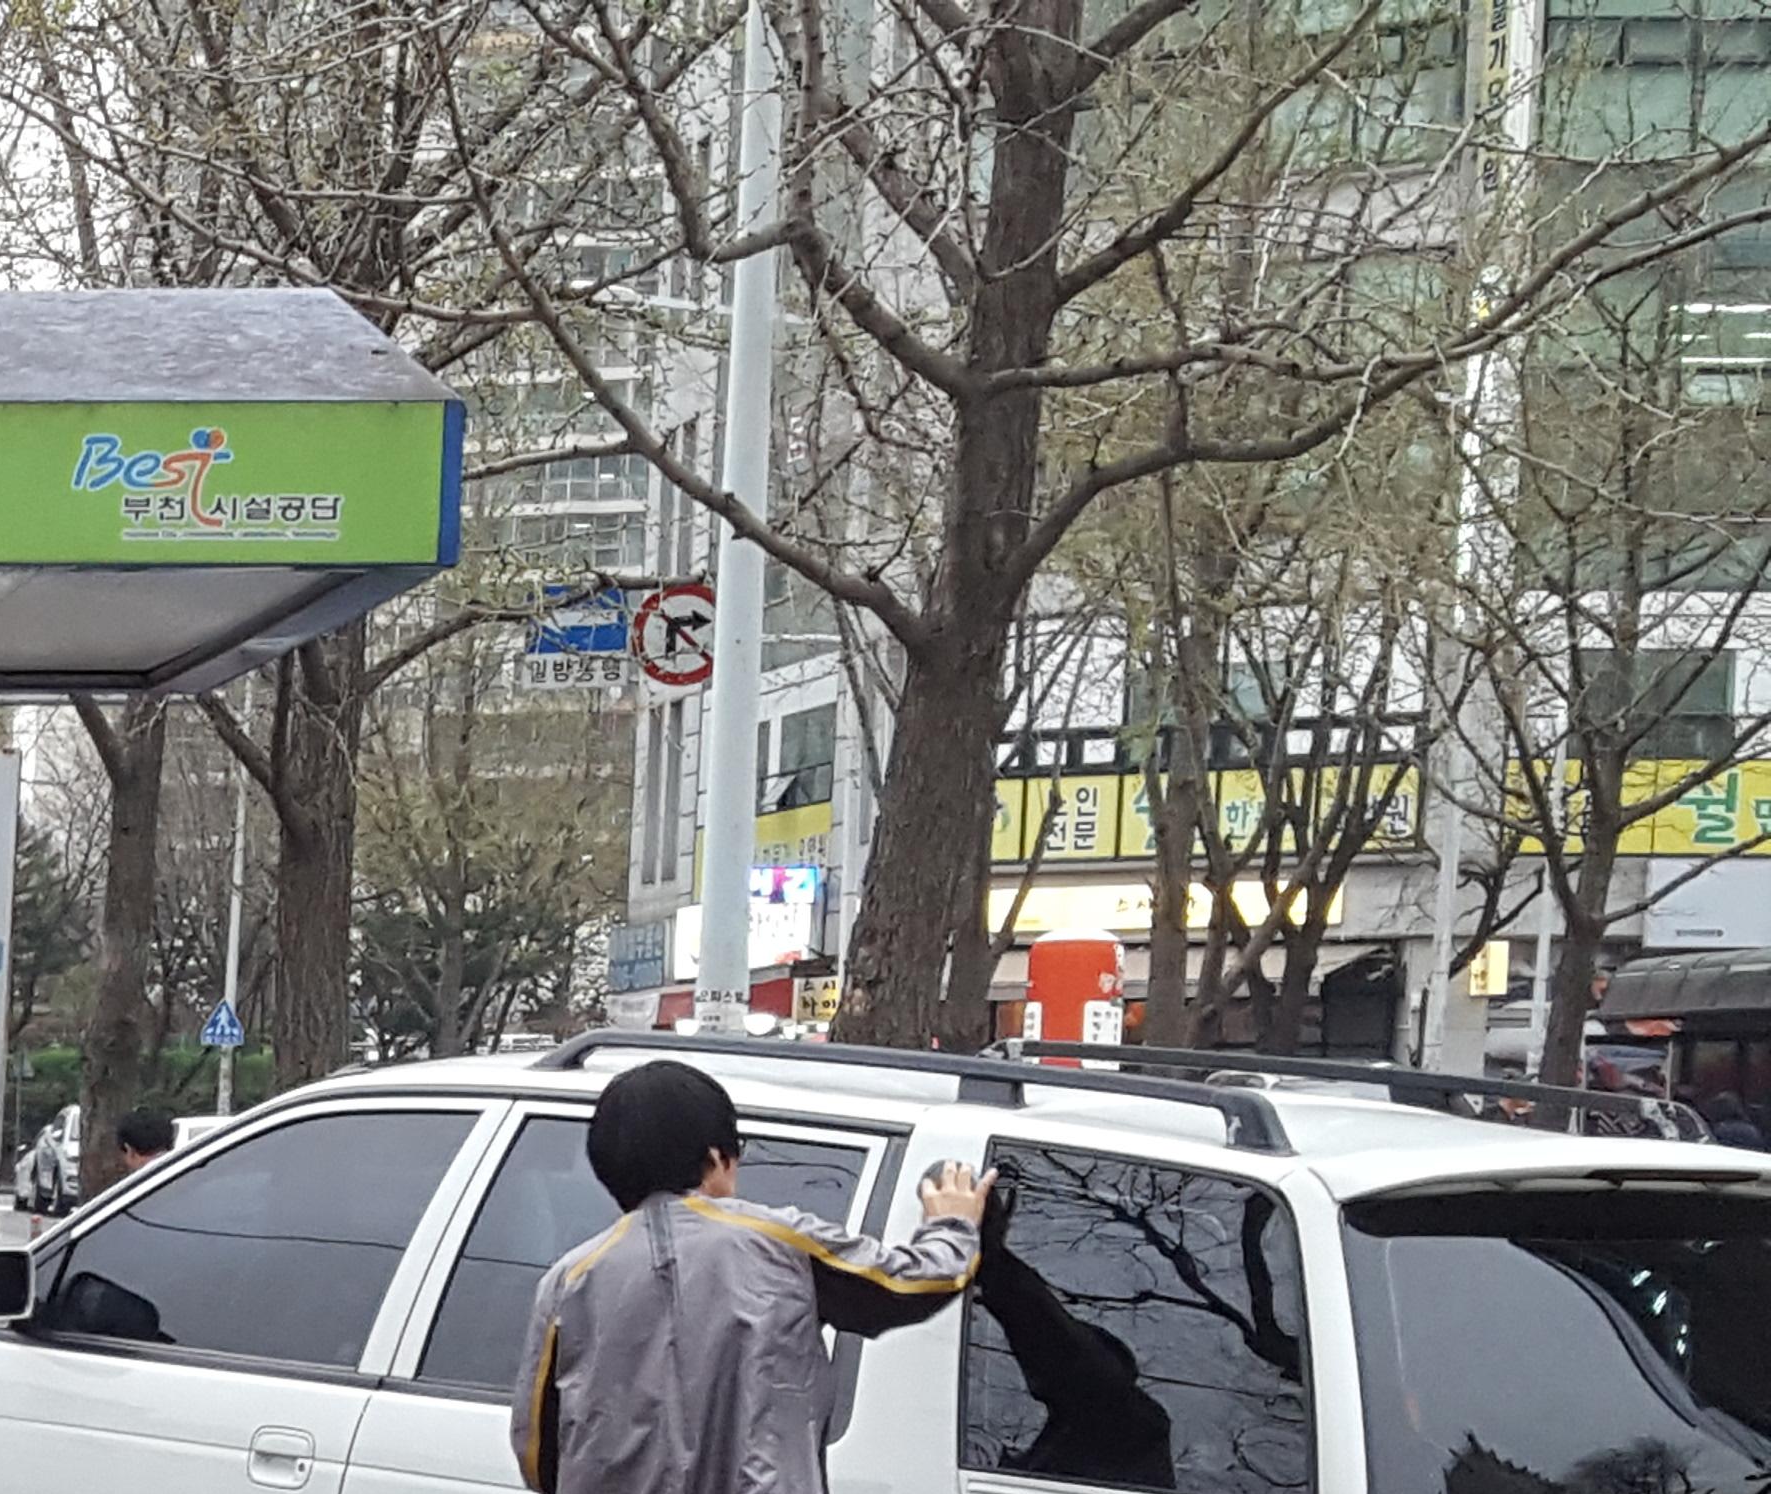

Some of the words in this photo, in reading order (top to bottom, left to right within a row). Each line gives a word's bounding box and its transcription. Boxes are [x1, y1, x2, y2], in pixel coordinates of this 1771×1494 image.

[73, 434, 232, 527] Best
[124, 497, 185, 520] 부천
[210, 496, 341, 520] 시설공단
